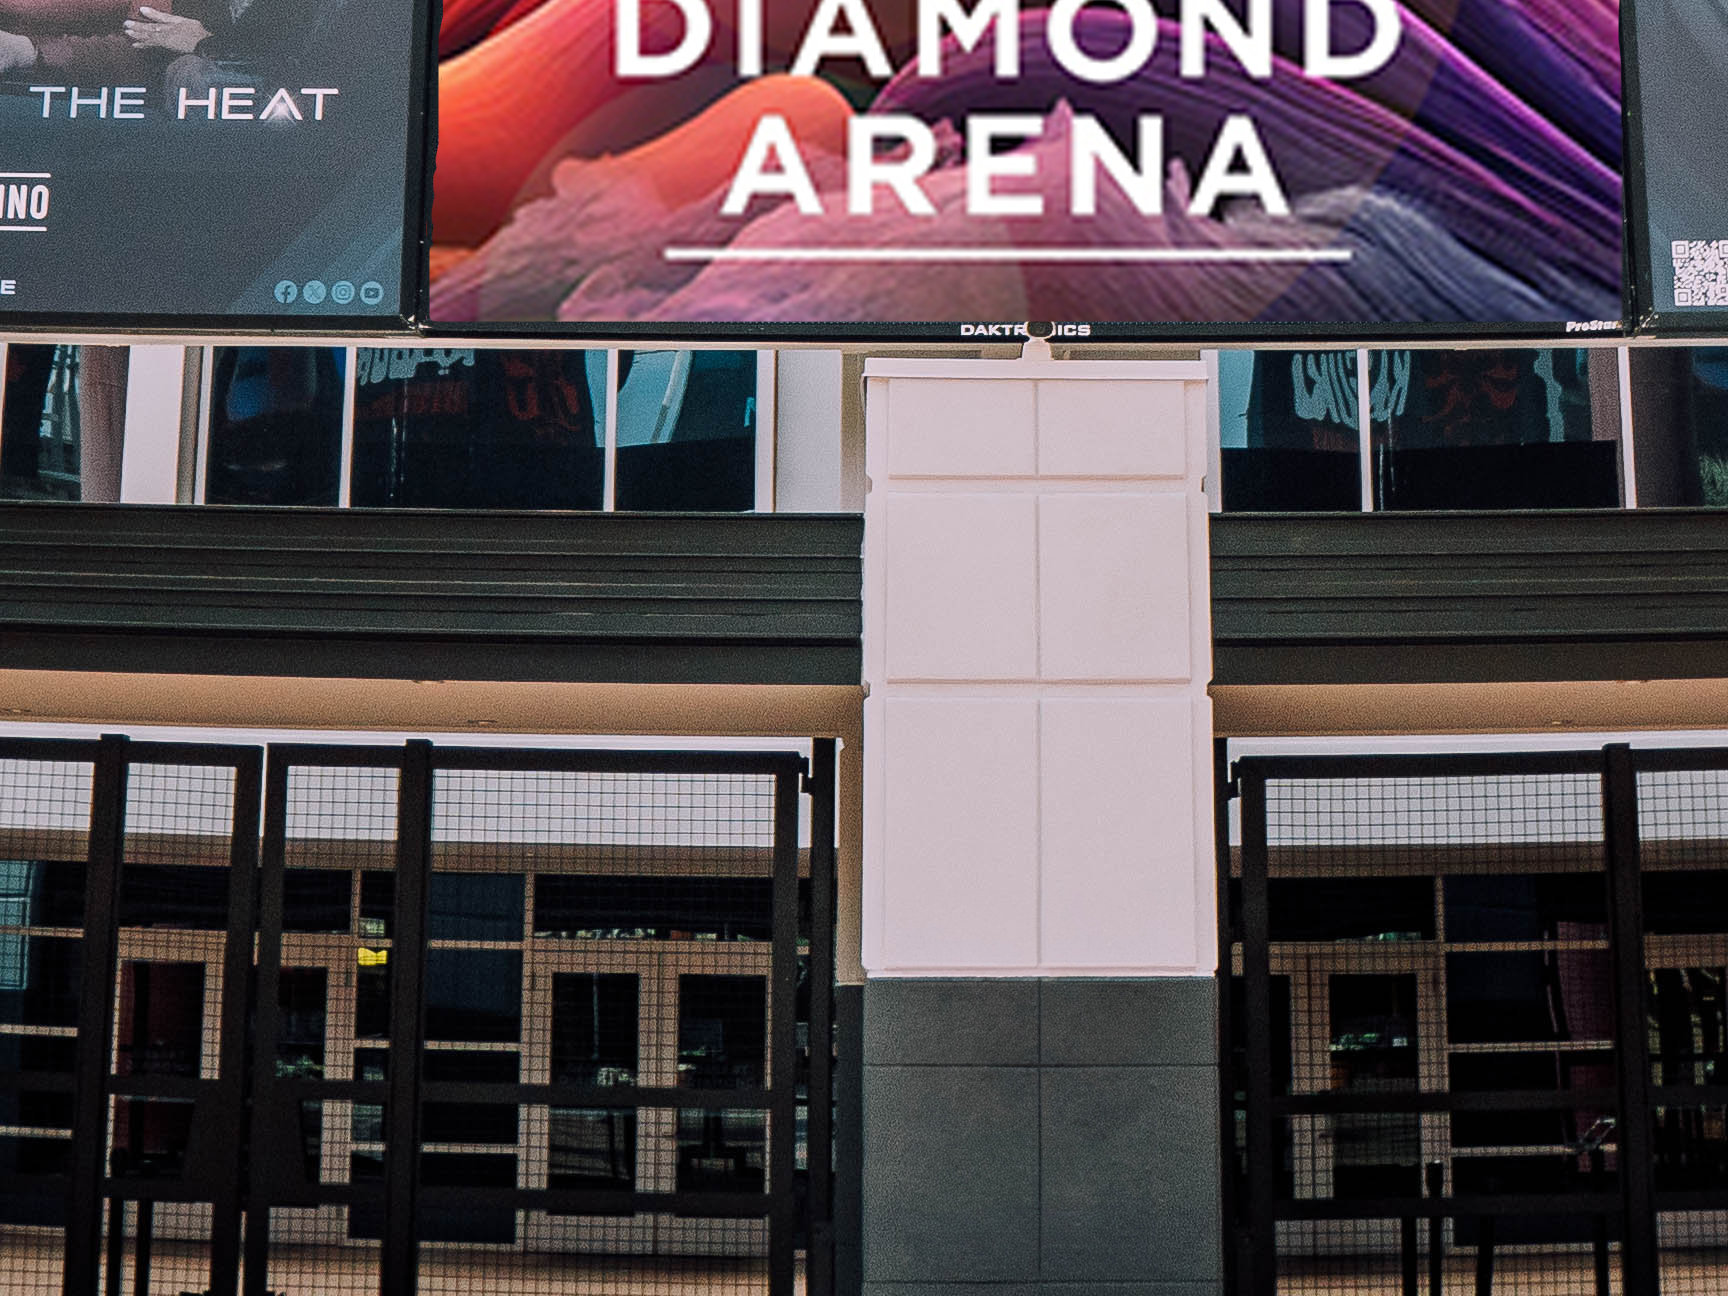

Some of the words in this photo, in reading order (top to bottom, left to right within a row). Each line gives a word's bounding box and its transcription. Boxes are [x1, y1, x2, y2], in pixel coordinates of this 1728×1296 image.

[29, 86, 147, 119] THE
[177, 86, 340, 122] HEAT
[720, 116, 1290, 216] ARENA
[960, 324, 1092, 336] DAKTRICS
